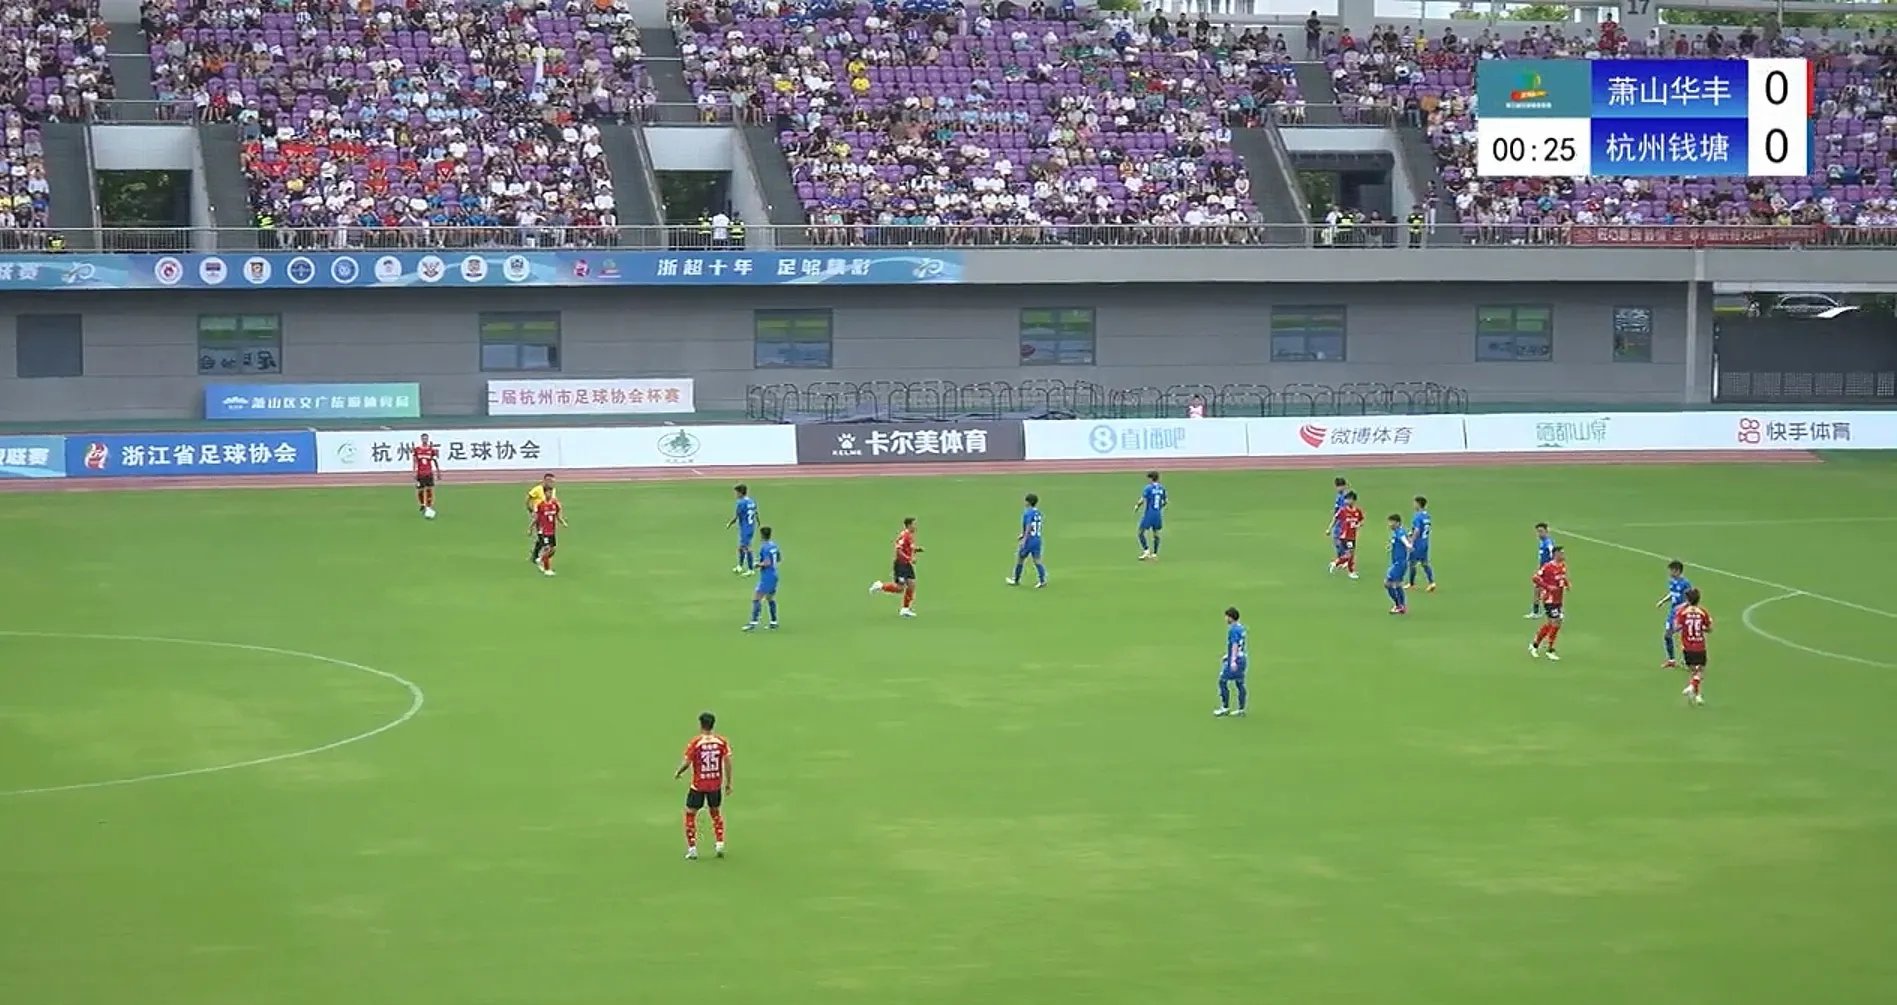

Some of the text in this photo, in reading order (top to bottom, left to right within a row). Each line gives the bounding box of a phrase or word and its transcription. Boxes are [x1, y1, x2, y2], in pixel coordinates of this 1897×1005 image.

[657, 258, 754, 276] 浙超十年
[1121, 427, 1186, 450] 直播吧
[1330, 425, 1414, 445] 微博体育
[1766, 422, 1851, 441] 快手体育
[865, 429, 988, 455] 卡尔美体育
[0, 448, 50, 466] 联赛
[122, 443, 297, 466] 浙江省足球协会
[701, 751, 720, 771] 35
